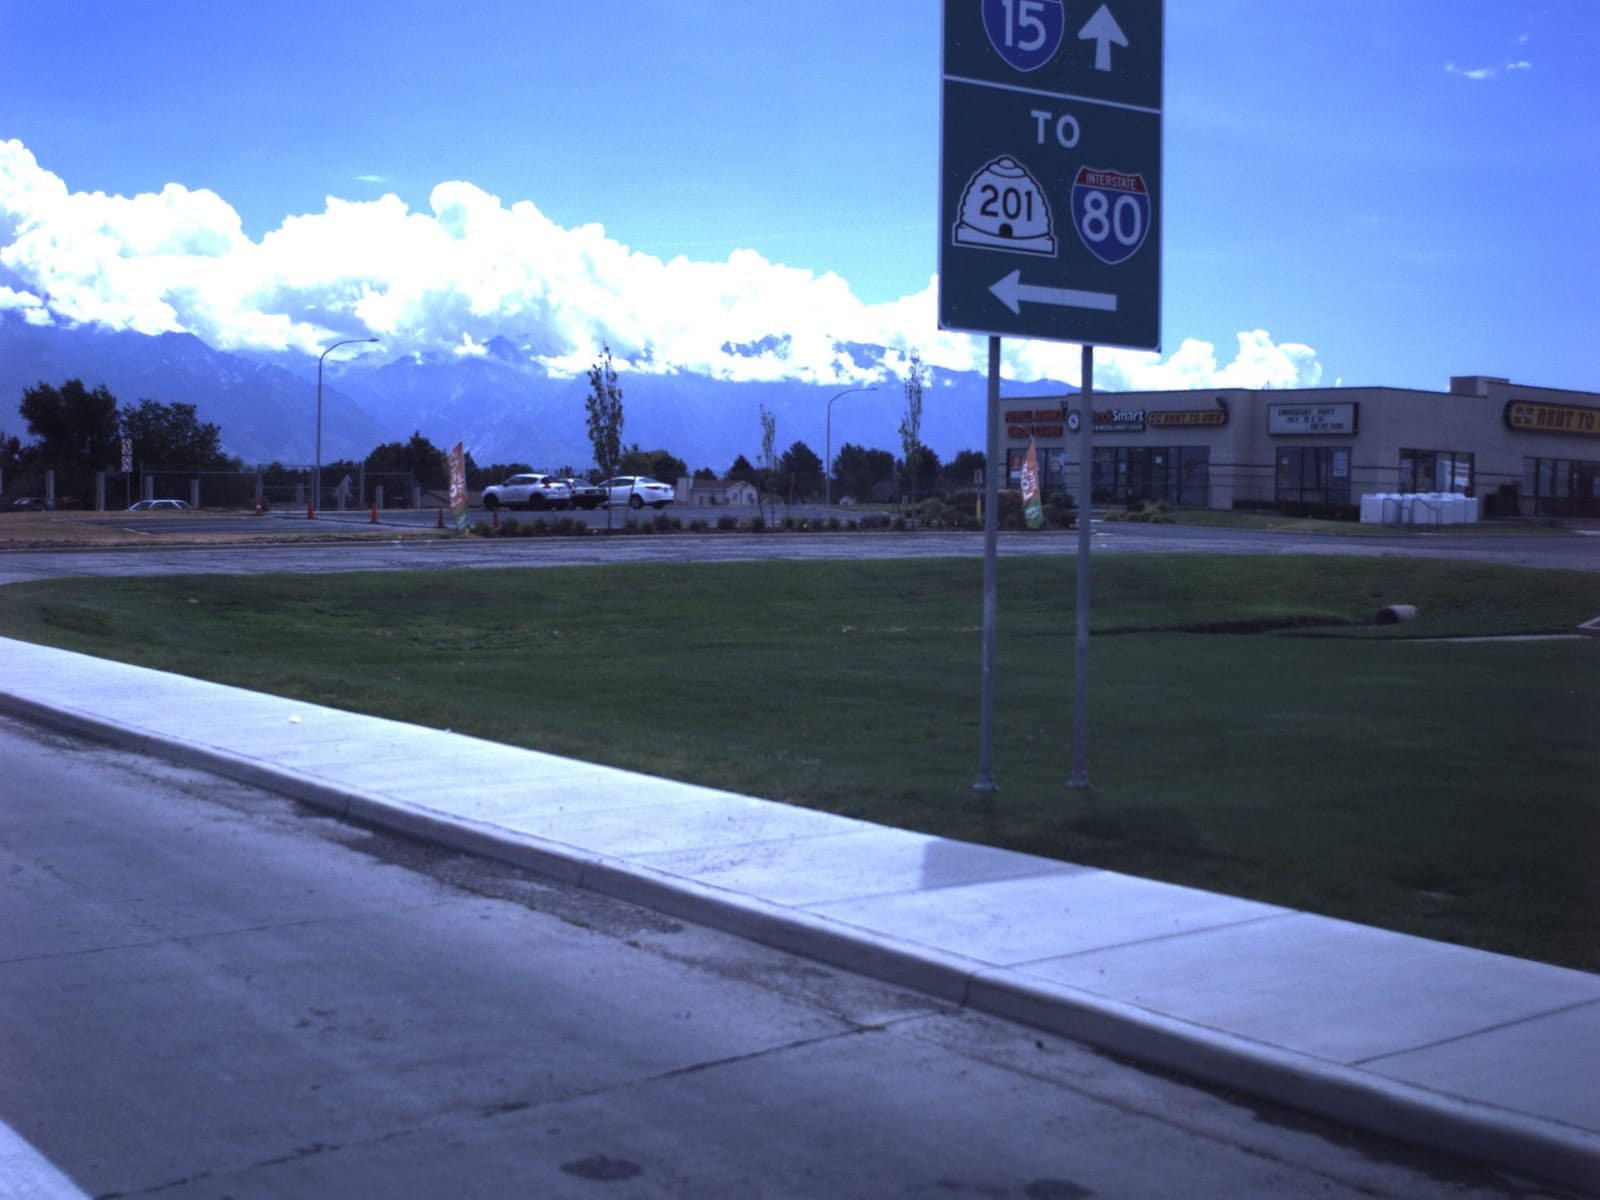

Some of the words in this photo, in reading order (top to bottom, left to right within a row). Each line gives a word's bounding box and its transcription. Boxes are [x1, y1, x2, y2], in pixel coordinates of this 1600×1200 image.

[1001, 0, 1047, 51] 15
[1030, 110, 1080, 148] TO
[1085, 171, 1138, 191] INTERSTATE
[979, 184, 1033, 223] 201
[1081, 190, 1142, 247] 80
[1112, 409, 1144, 422] Smart
